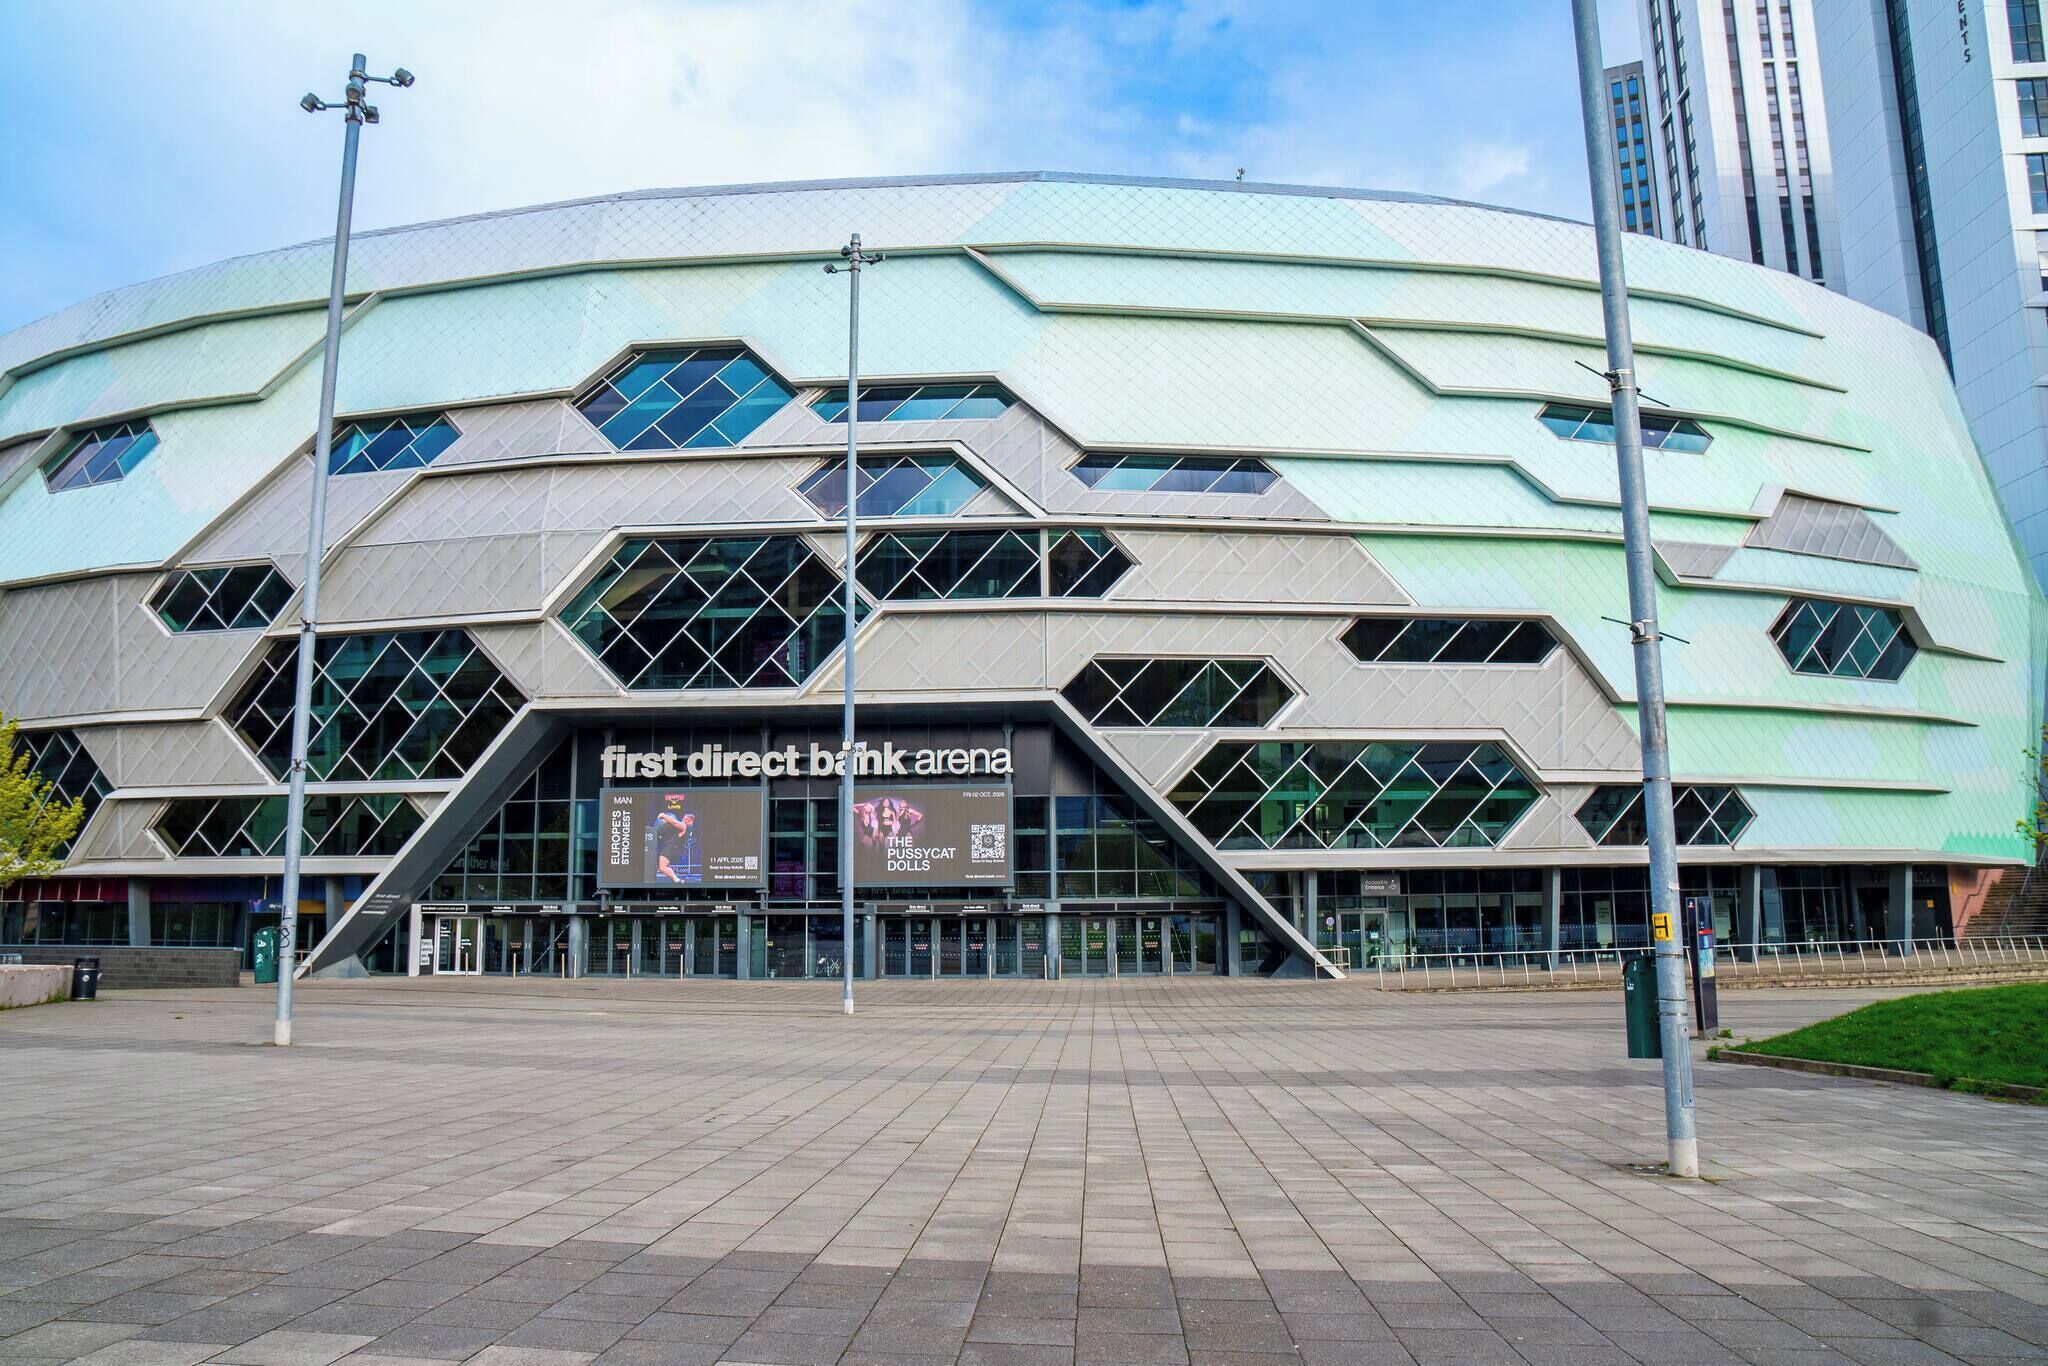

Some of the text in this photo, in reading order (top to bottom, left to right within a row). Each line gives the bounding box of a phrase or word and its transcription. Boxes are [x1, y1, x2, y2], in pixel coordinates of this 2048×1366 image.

[600, 741, 1014, 778] first direct bank arena
[613, 796, 633, 805] MAN
[610, 810, 622, 866] EUROPE'S
[622, 810, 632, 866] STRONGEST
[887, 836, 913, 848] THE
[887, 848, 956, 860] PUSSYCAT
[887, 860, 931, 872] DOLLS
